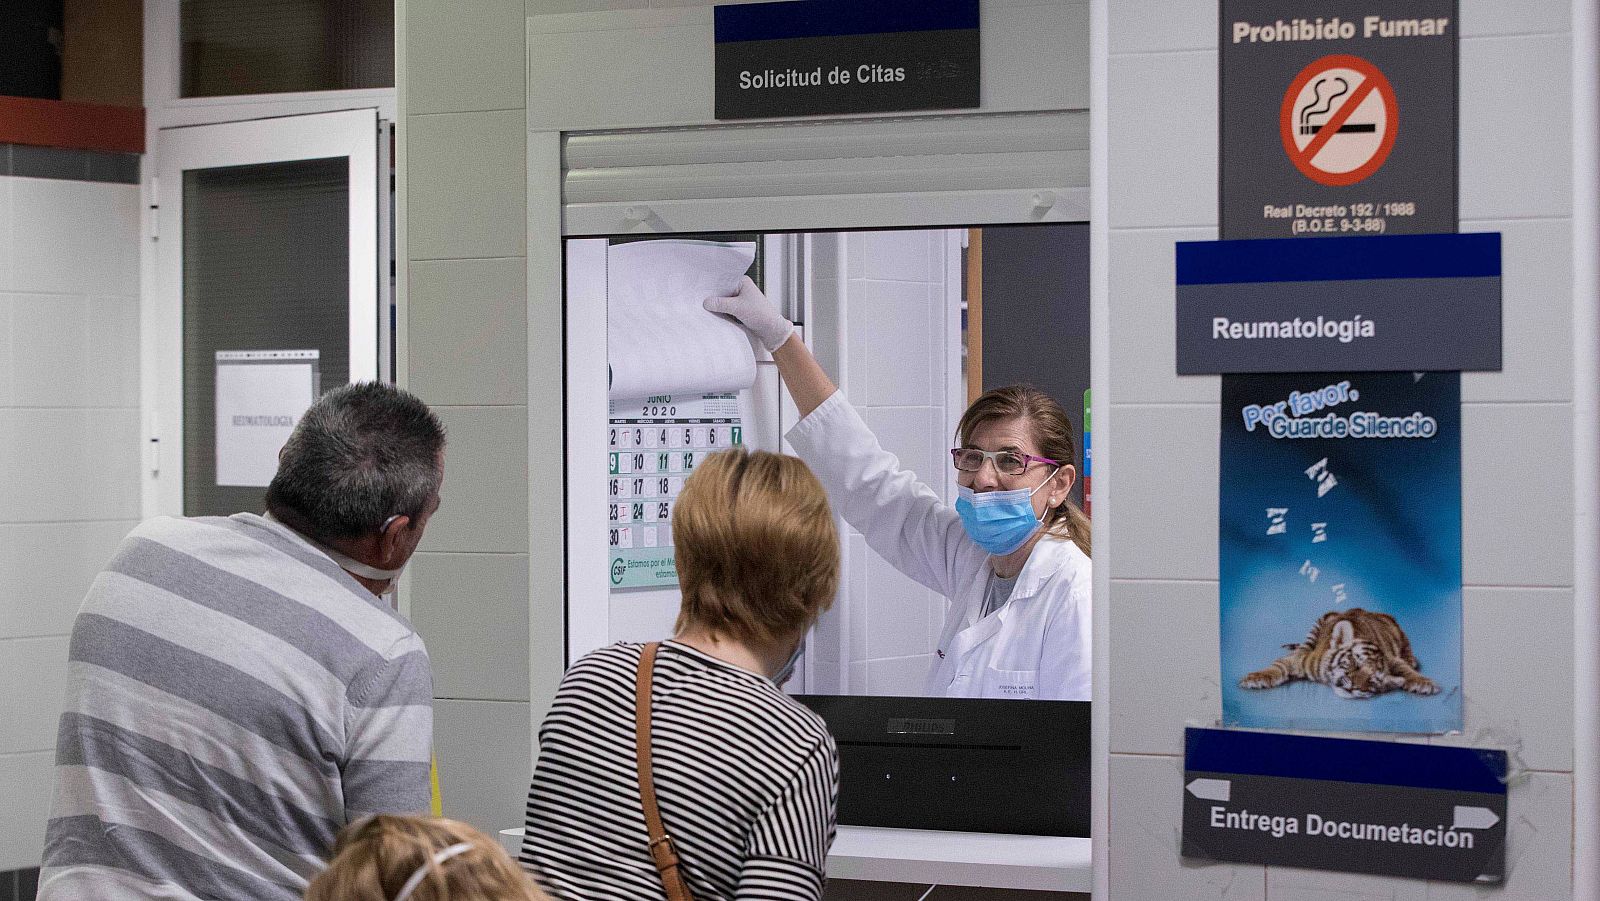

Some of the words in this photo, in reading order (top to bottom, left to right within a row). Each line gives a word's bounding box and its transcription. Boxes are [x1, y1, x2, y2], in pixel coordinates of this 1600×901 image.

[1232, 18, 1355, 43] Prohibido
[1364, 15, 1449, 38] Fumar
[739, 67, 821, 90] Solicitud
[827, 66, 850, 85] de
[856, 64, 906, 83] Citas
[1263, 204, 1293, 219] Real
[1295, 204, 1346, 218] Decreto
[1350, 203, 1372, 217] 192
[1383, 202, 1415, 217] 1988
[1292, 219, 1337, 234] (B.O.E.
[1212, 314, 1375, 343] Reumatología
[642, 406, 676, 416] 2020
[1242, 401, 1286, 431] Por
[1268, 413, 1348, 439] Guarde
[1349, 412, 1438, 439] Silencio
[610, 428, 616, 446] 2
[635, 428, 641, 446] 3
[660, 428, 666, 445] 4
[685, 428, 691, 445] 5
[709, 428, 715, 444] 6
[733, 428, 739, 444] 7
[610, 454, 616, 471] 9
[634, 454, 644, 470] 10
[659, 453, 668, 469] 11
[684, 453, 693, 469] 12
[609, 479, 618, 496] 16
[634, 479, 643, 495] 17
[659, 478, 669, 494] 18
[609, 504, 618, 520] 23
[633, 503, 643, 519] 24
[658, 503, 669, 519] 25
[609, 529, 619, 546] 30
[627, 559, 649, 569] Estamos
[650, 560, 660, 569] por
[660, 558, 667, 567] el
[667, 557, 676, 566] Me
[1210, 806, 1298, 838] Entrega
[1305, 813, 1474, 849] Documetación
